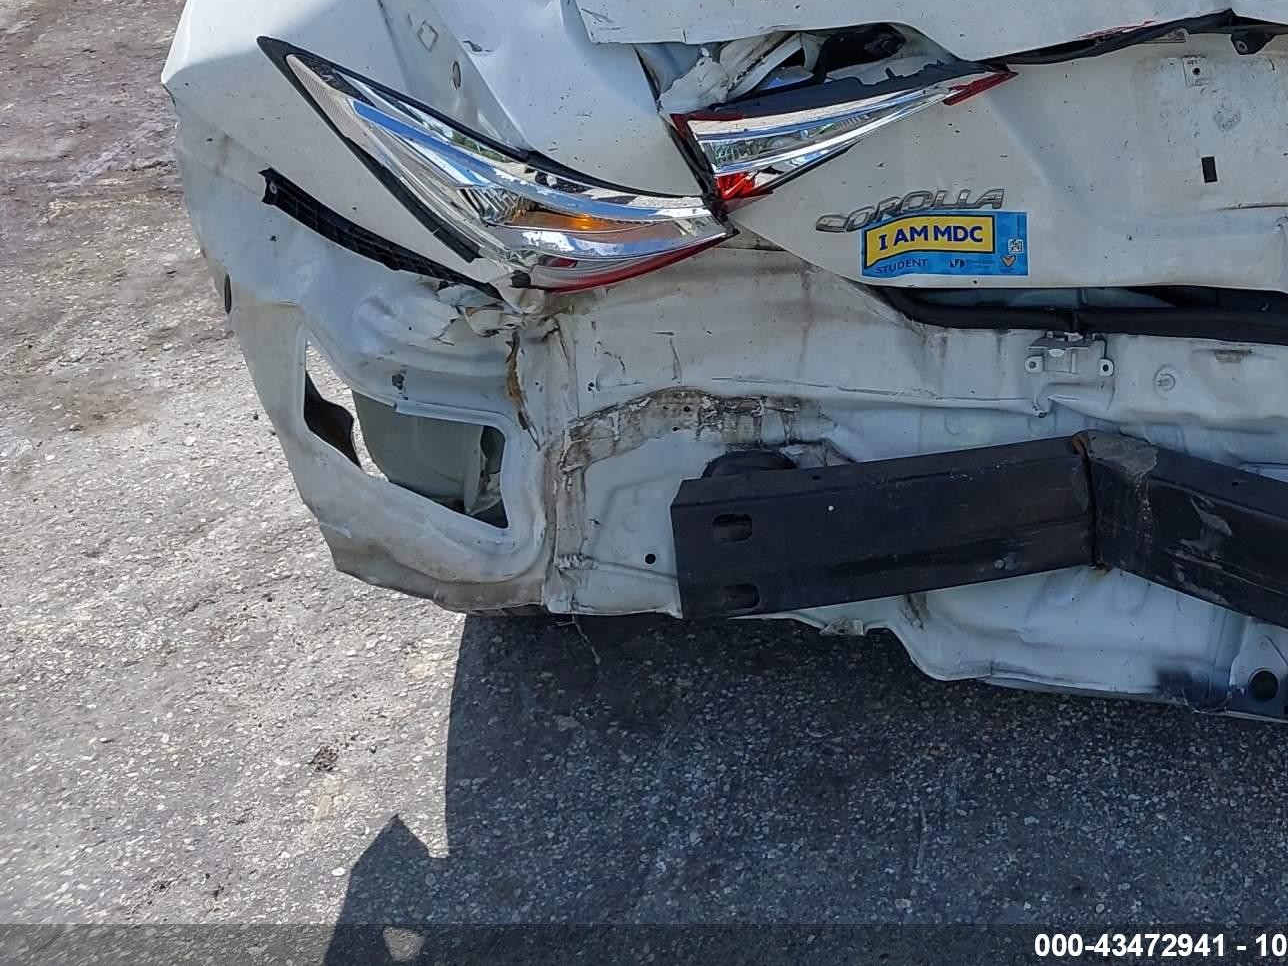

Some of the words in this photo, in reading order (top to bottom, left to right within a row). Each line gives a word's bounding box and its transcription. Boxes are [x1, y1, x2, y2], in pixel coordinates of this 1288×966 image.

[815, 188, 1005, 232] COROLLA
[878, 234, 888, 251] I
[893, 225, 929, 246] AM
[933, 225, 983, 243] MDC
[876, 258, 928, 274] STUDENT
